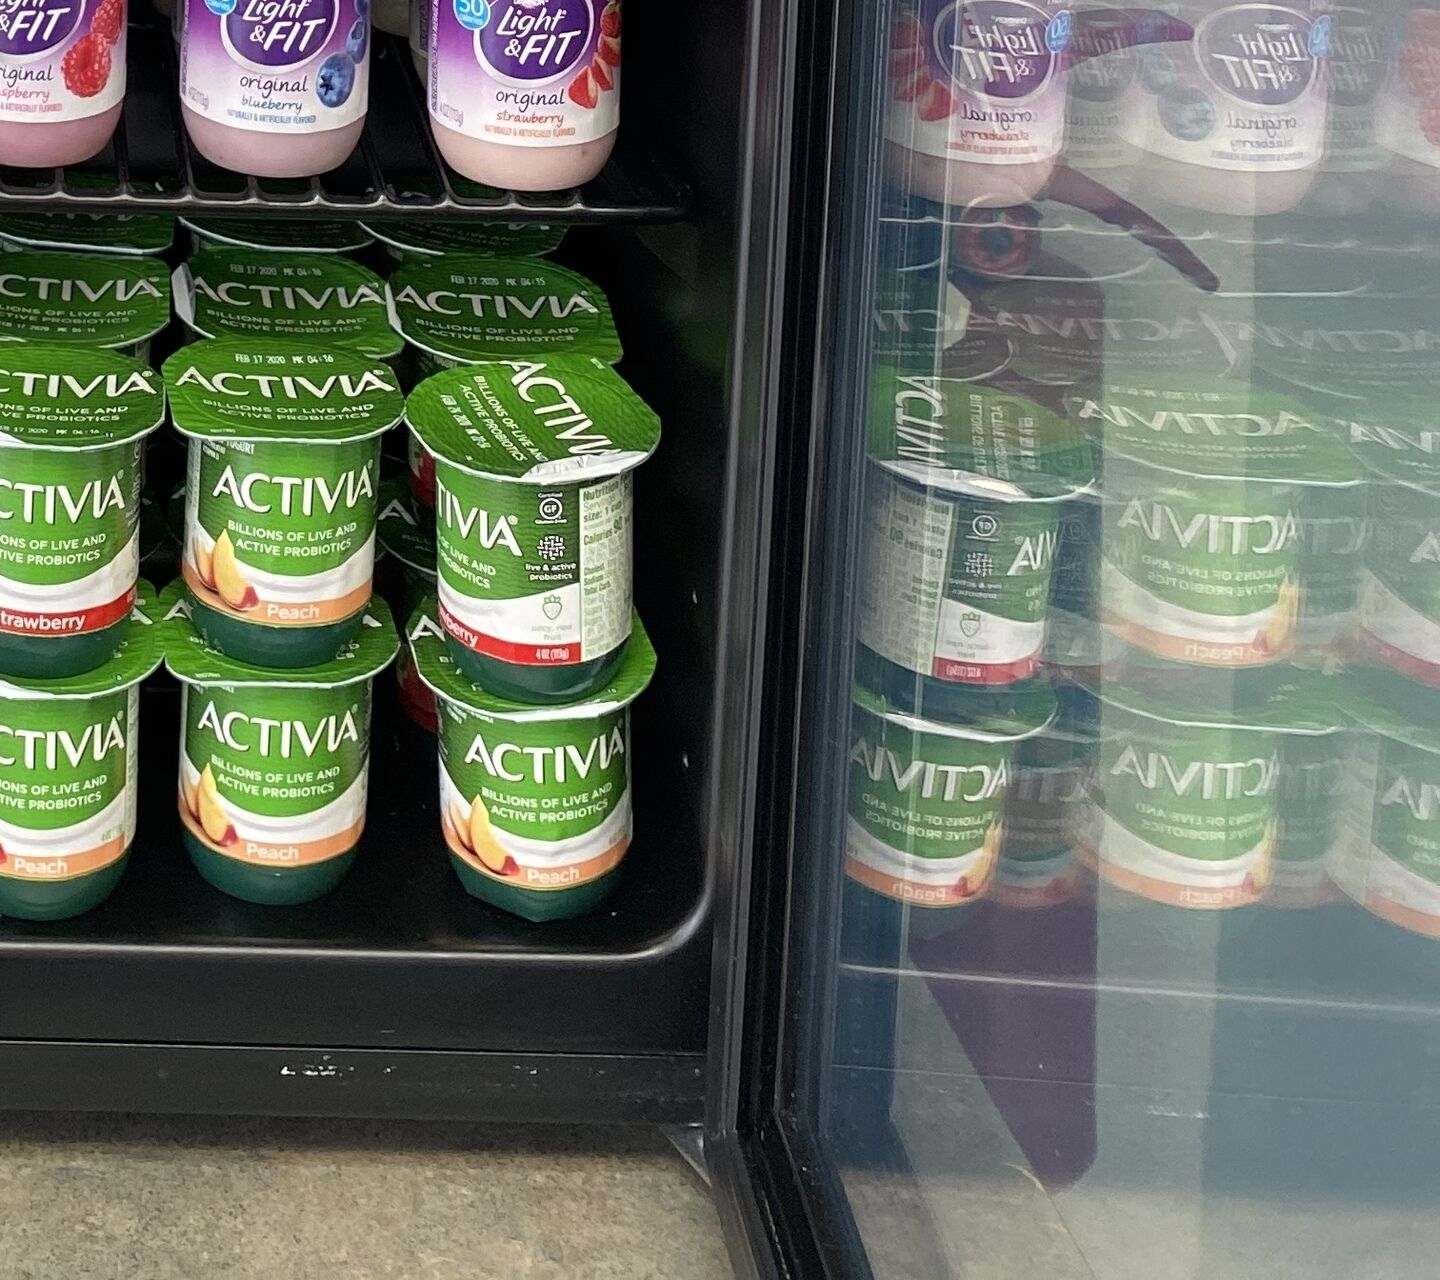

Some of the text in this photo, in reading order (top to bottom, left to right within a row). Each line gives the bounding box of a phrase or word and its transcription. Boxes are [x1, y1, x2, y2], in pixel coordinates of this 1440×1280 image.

[495, 5, 565, 38] Light
[239, 76, 309, 97] original
[241, 96, 304, 111] blueberry
[496, 89, 566, 116] original
[496, 109, 565, 126] strawberry
[235, 354, 285, 364] FEB 17 2020
[177, 366, 395, 398] ACTIVIA
[212, 465, 373, 516] ACTIVIA
[30, 537, 47, 550] OF
[50, 536, 78, 550] LIVE
[81, 532, 106, 547] AND
[28, 549, 101, 565] PROBIOTICS
[267, 603, 320, 621] Peach
[197, 700, 358, 759] ACTIVIA
[464, 724, 624, 785] ACTIVIA
[246, 843, 299, 862] Peach
[14, 857, 68, 875] Peach
[528, 866, 580, 884] Peach
